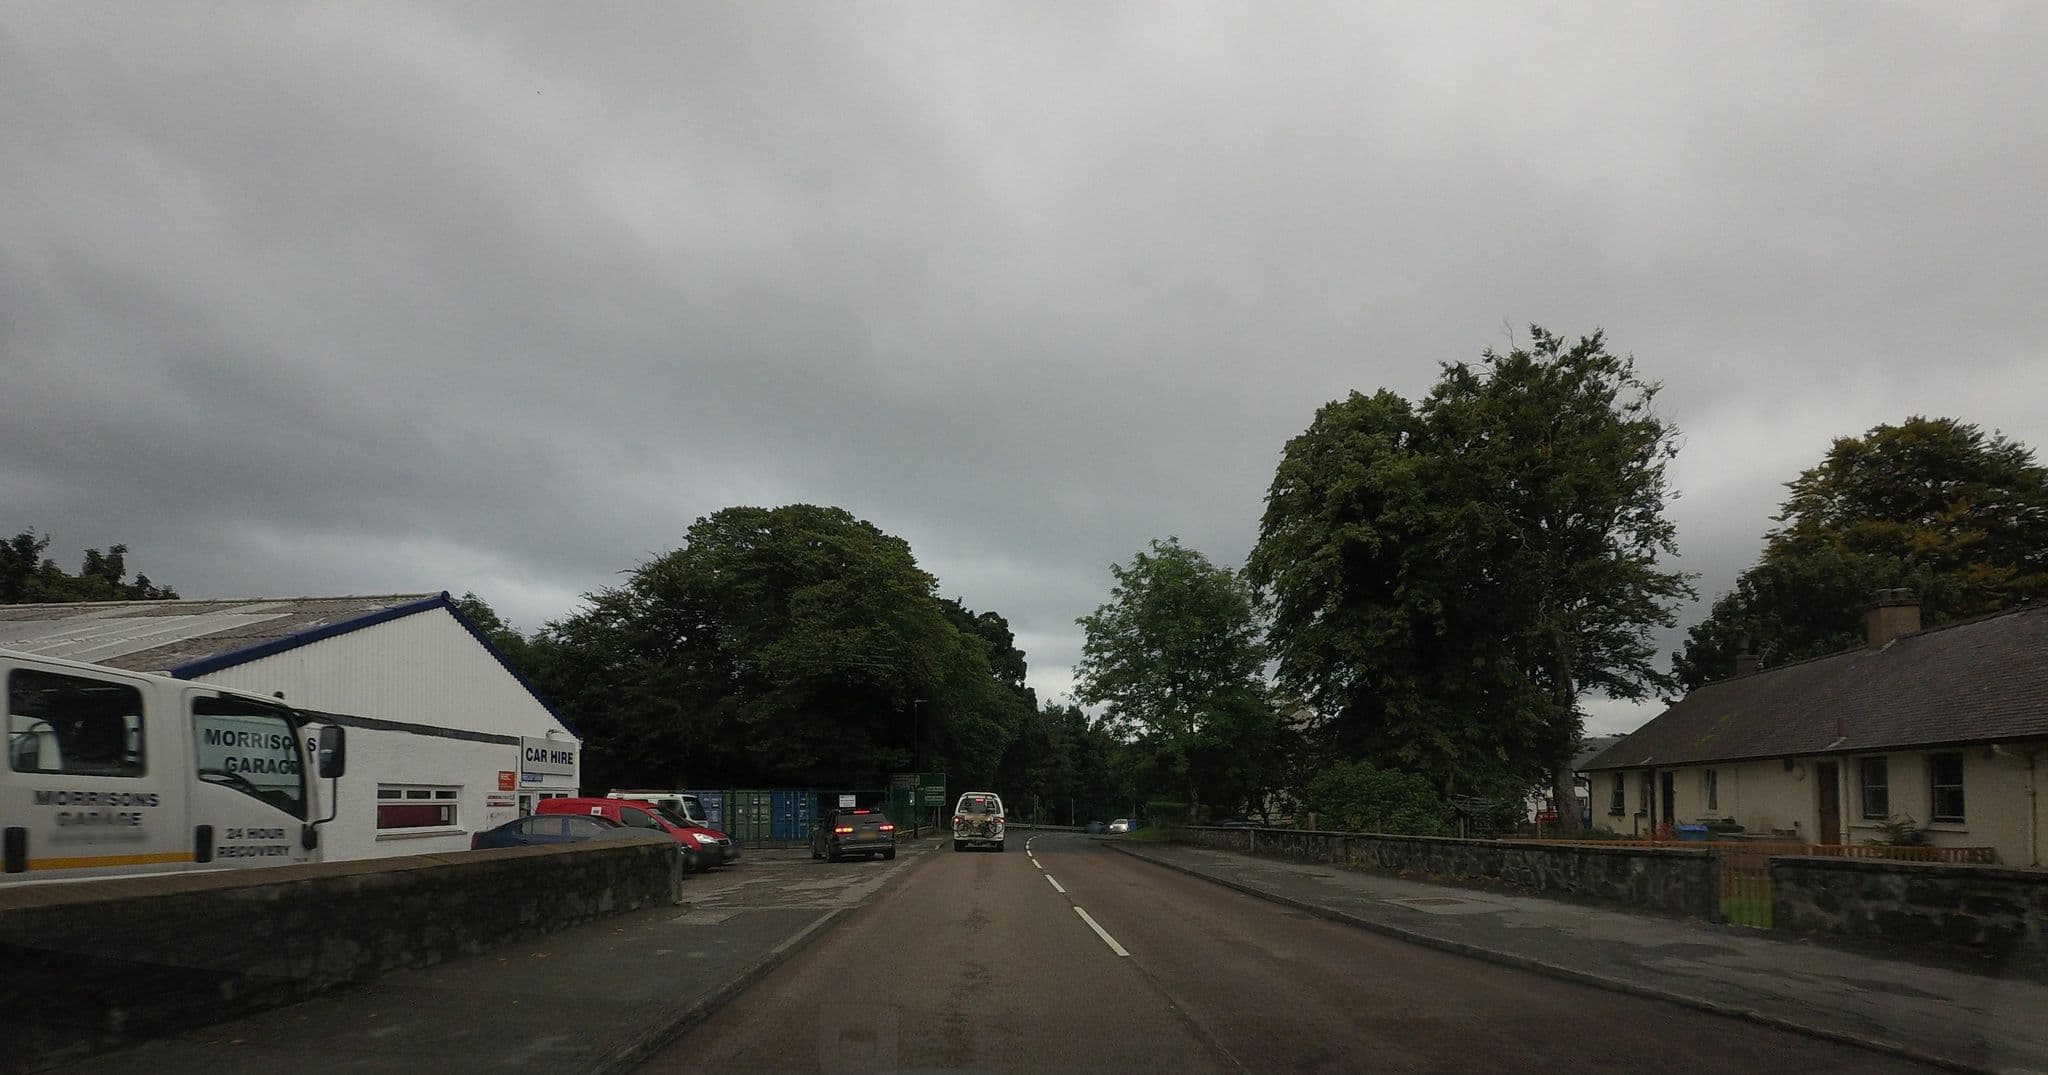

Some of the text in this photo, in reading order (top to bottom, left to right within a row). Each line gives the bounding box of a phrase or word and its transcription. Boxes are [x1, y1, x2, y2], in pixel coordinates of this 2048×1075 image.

[204, 728, 317, 752] MORRISOS
[525, 747, 574, 765] CAR HIRE
[34, 790, 159, 807] MORRISONS
[56, 811, 142, 826] GARAGE
[226, 828, 285, 840] 24 HOUR
[217, 844, 292, 858] RECOVERY
